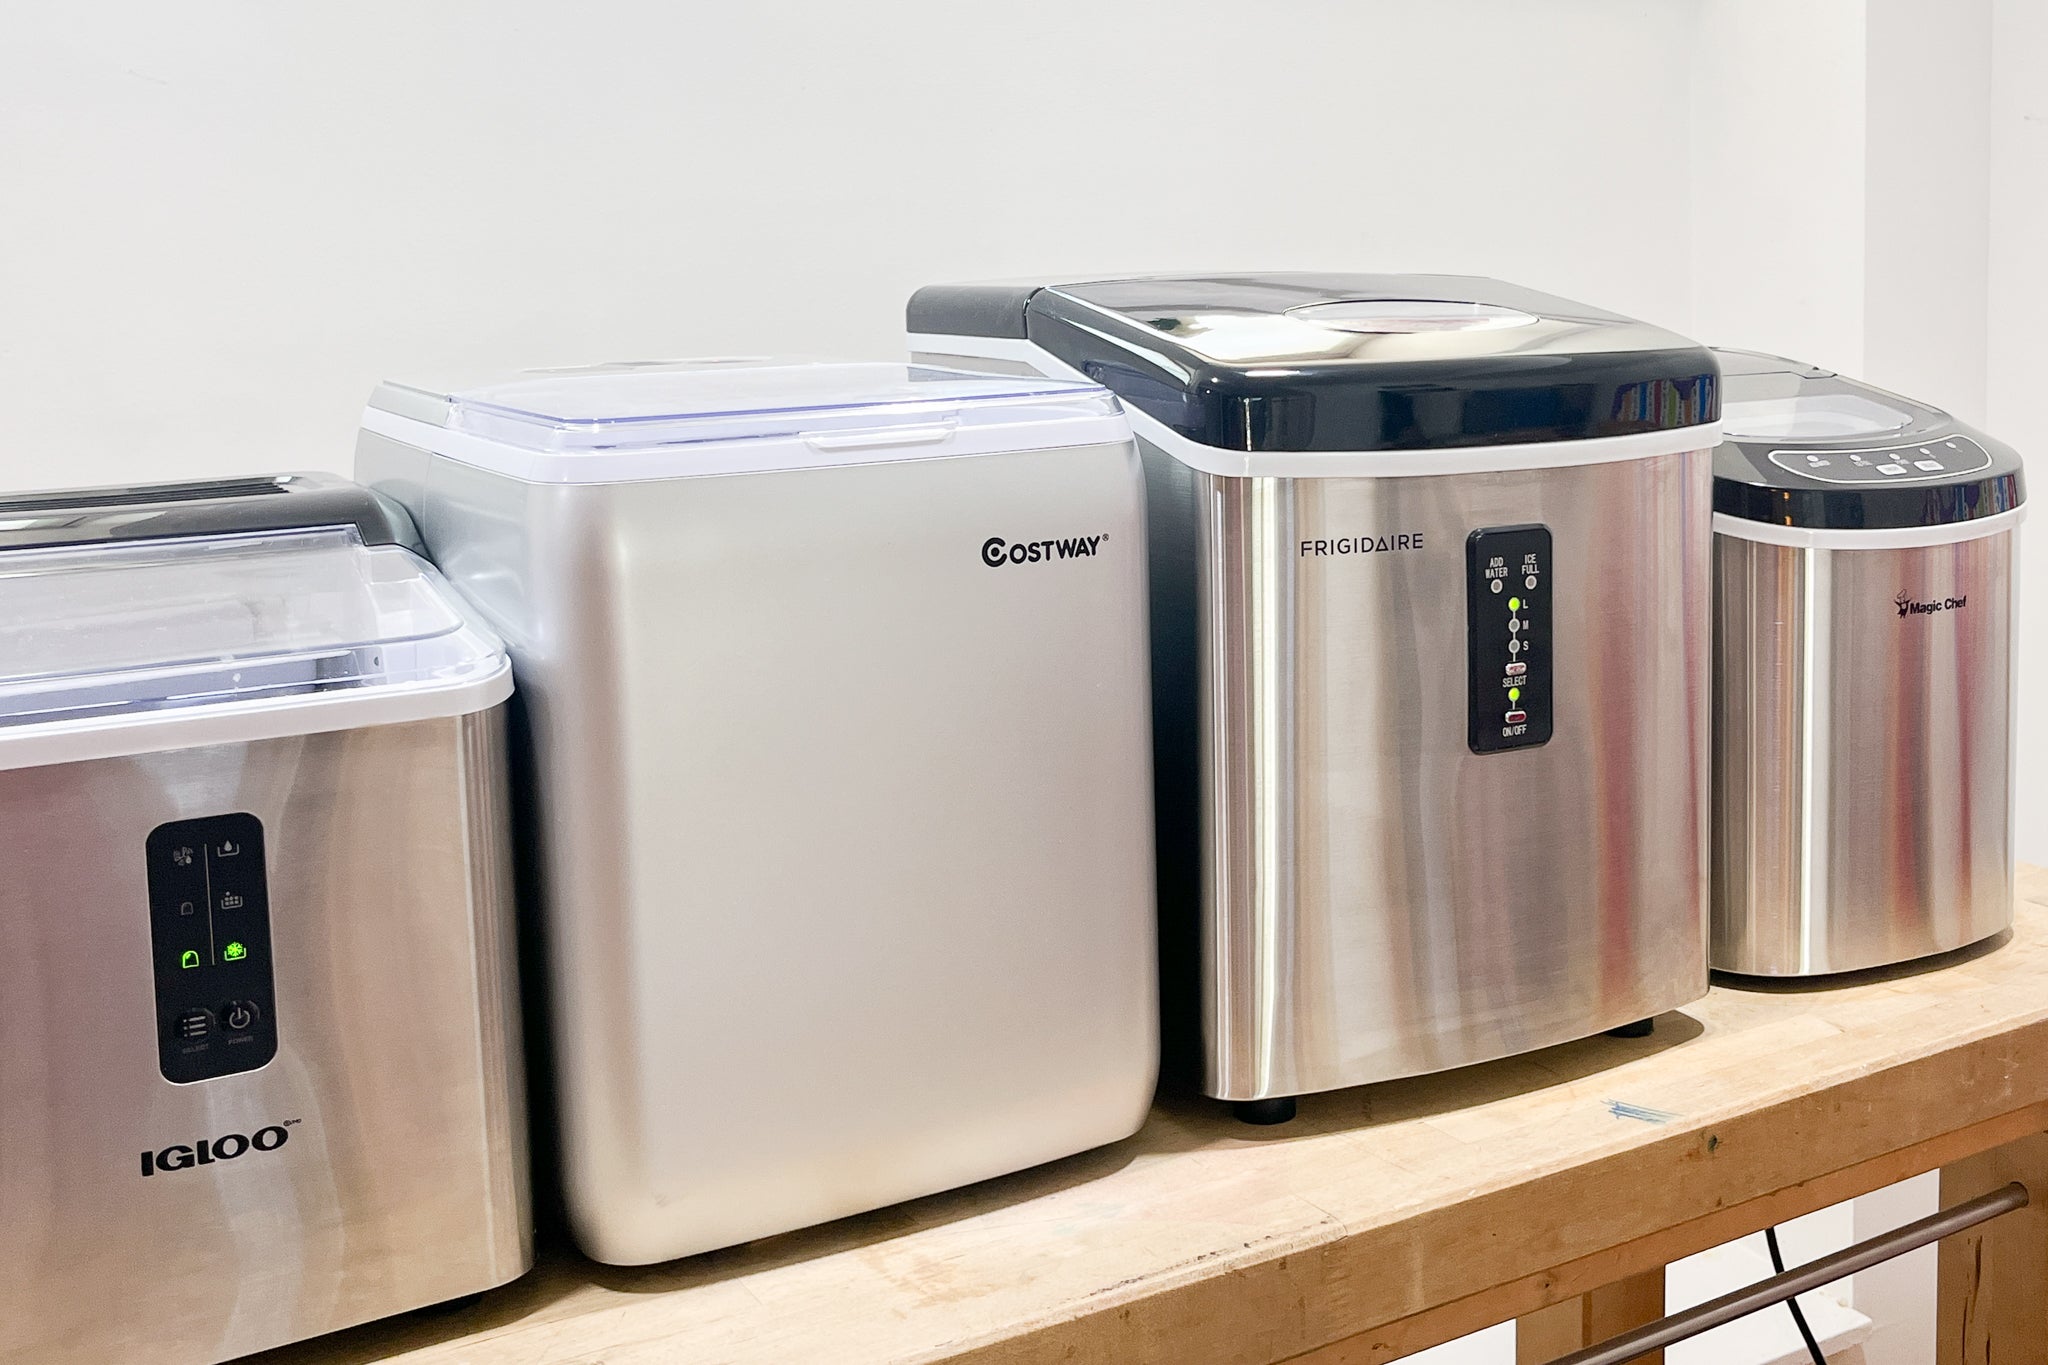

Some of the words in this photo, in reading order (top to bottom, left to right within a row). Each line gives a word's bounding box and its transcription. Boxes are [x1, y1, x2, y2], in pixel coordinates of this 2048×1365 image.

[1300, 533, 1424, 557] FRIGIDAIRE
[1489, 556, 1504, 568] ADD
[1524, 553, 1537, 565] ICE
[1485, 566, 1508, 579] WATER
[1521, 564, 1540, 575] FULL
[1522, 599, 1529, 609] L
[1909, 600, 1942, 615] Magic
[1944, 595, 1967, 610] Chef
[1522, 620, 1529, 630] M
[1522, 640, 1529, 651] S
[1502, 675, 1528, 688] SELECT
[1502, 724, 1528, 738] ON/OFF
[141, 1125, 289, 1177] IGLOO
